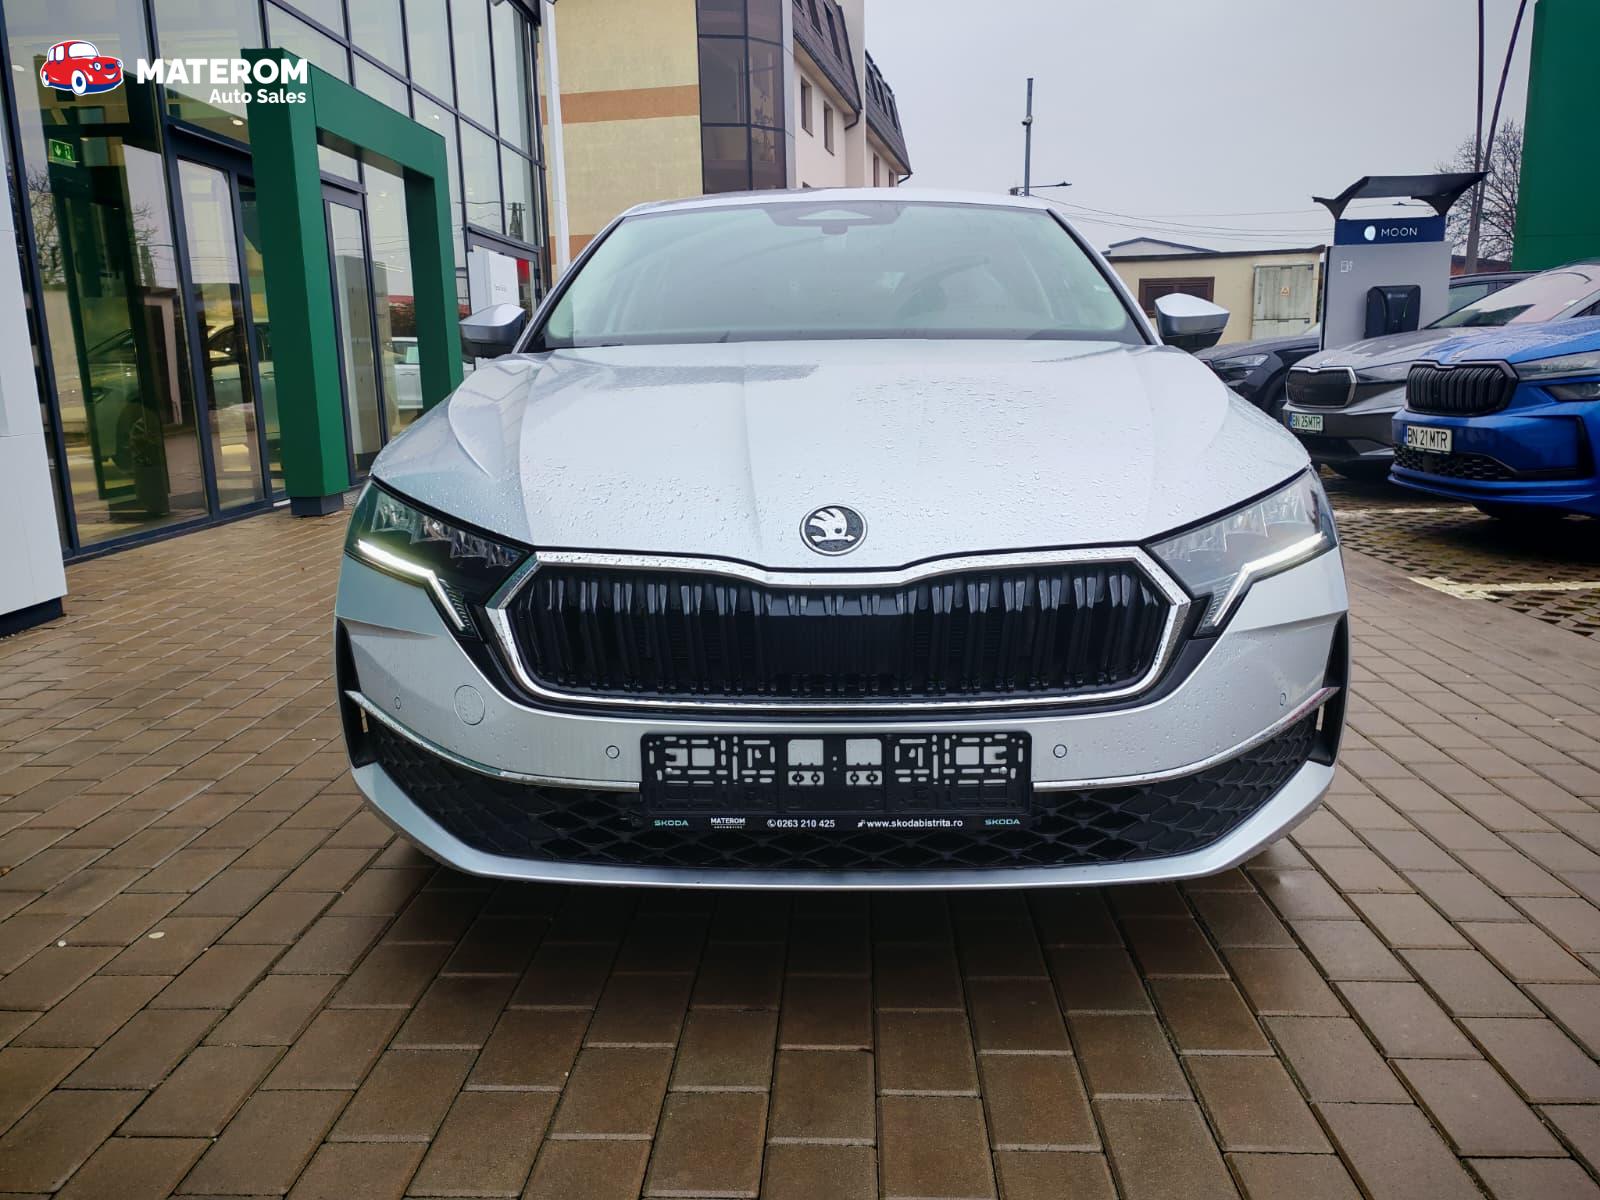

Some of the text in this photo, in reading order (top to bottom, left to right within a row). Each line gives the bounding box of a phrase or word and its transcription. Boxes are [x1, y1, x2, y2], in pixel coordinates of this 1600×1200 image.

[1381, 227, 1418, 237] MOON
[1407, 427, 1418, 445] BN
[710, 817, 746, 825] MATEROM
[776, 819, 836, 828] 0263 210 425
[866, 818, 964, 828] www.skodabistrita.ro
